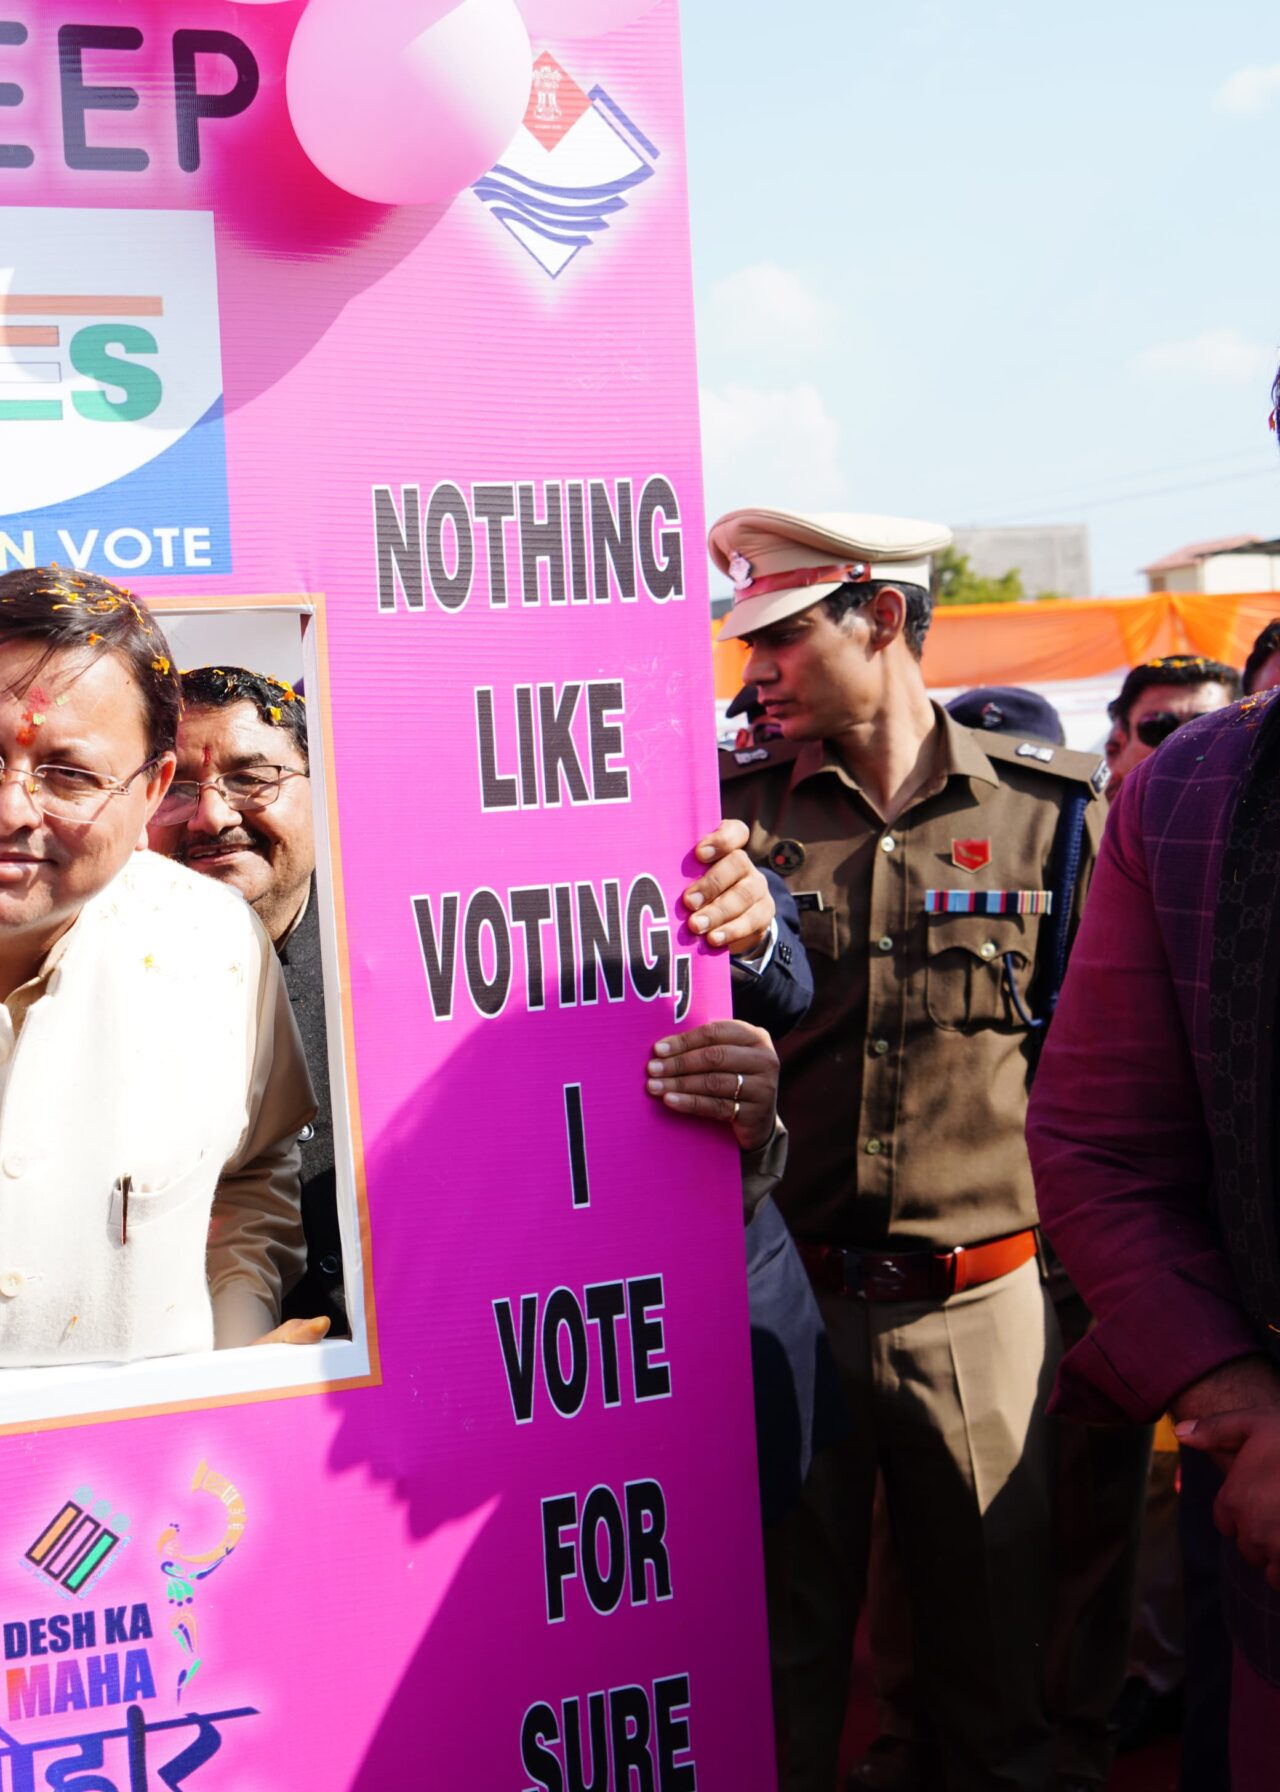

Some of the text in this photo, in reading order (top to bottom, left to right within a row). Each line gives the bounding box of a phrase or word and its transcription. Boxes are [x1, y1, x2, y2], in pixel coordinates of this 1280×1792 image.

[57, 527, 213, 570] VOTE
[372, 473, 686, 613] NOTHING
[474, 678, 631, 813] LIKE
[410, 873, 691, 1023] VOTING,
[563, 1082, 590, 1209] I
[492, 1273, 672, 1425] VOTE
[541, 1477, 673, 1624] FOR
[3, 1602, 153, 1660] DESH KA
[6, 1648, 156, 1722] MAHA
[521, 1672, 697, 1792] SURE
